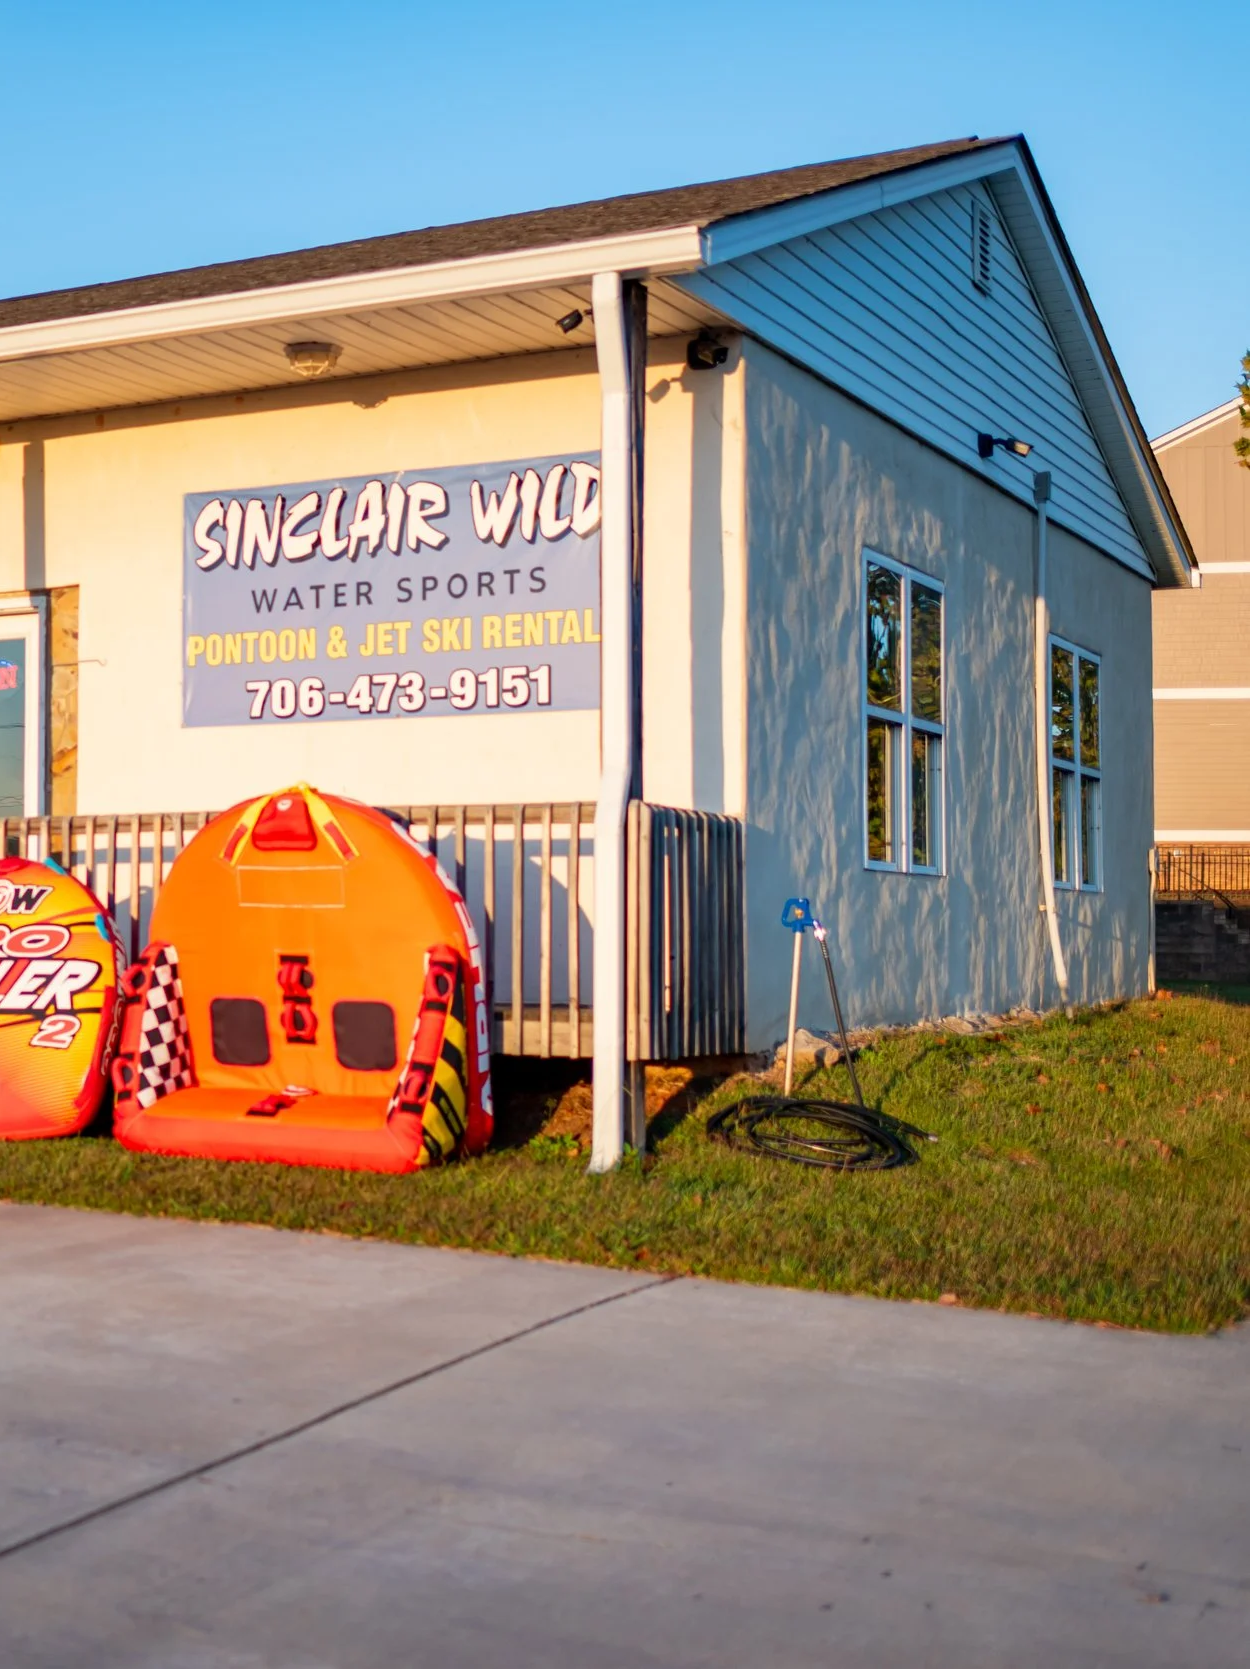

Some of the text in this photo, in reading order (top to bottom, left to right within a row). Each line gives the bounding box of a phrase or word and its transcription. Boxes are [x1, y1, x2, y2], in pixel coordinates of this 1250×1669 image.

[194, 461, 601, 571] SINCLAIR WILD
[251, 566, 548, 613] WATER SPORTS
[187, 608, 601, 667] PONTOON & JET SKI RENTAL
[246, 664, 552, 720] 706-473-9151
[30, 1014, 81, 1049] 2
